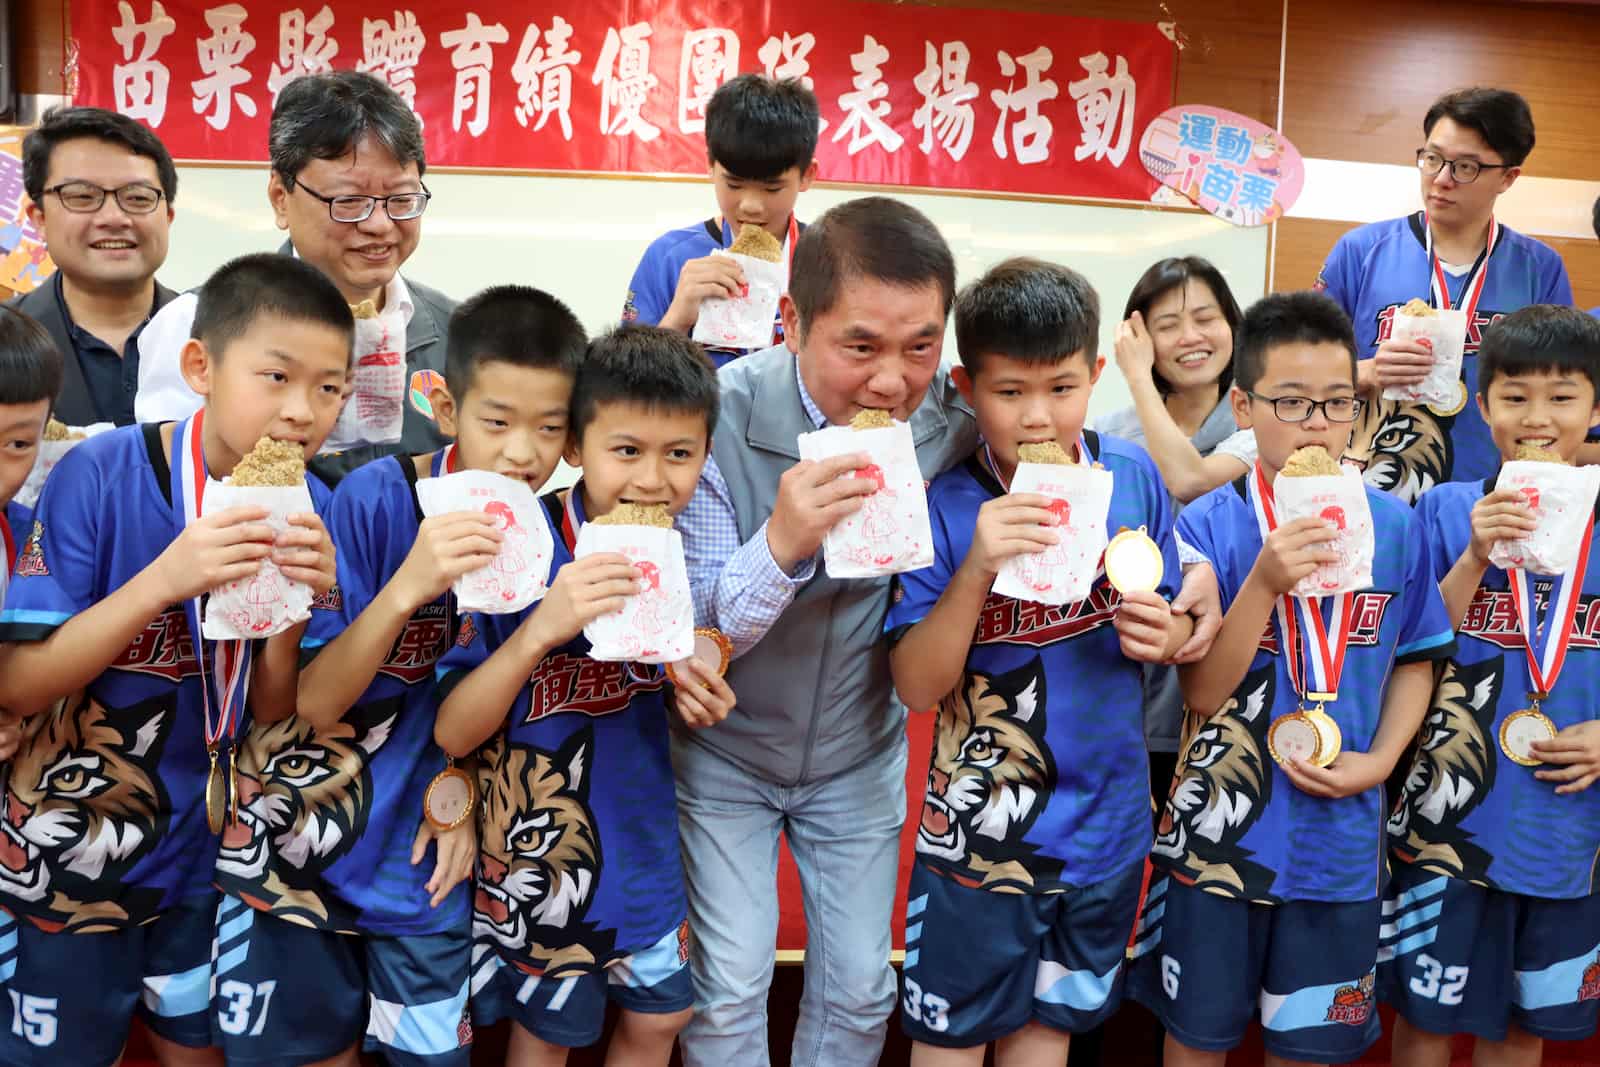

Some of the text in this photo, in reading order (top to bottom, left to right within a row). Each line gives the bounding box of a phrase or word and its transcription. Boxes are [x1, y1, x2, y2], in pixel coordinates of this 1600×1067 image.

[1179, 113, 1251, 164] 運動
[904, 976, 951, 1032] 33
[1409, 953, 1469, 1006] 32
[8, 988, 58, 1047] 15
[218, 980, 277, 1036] 37
